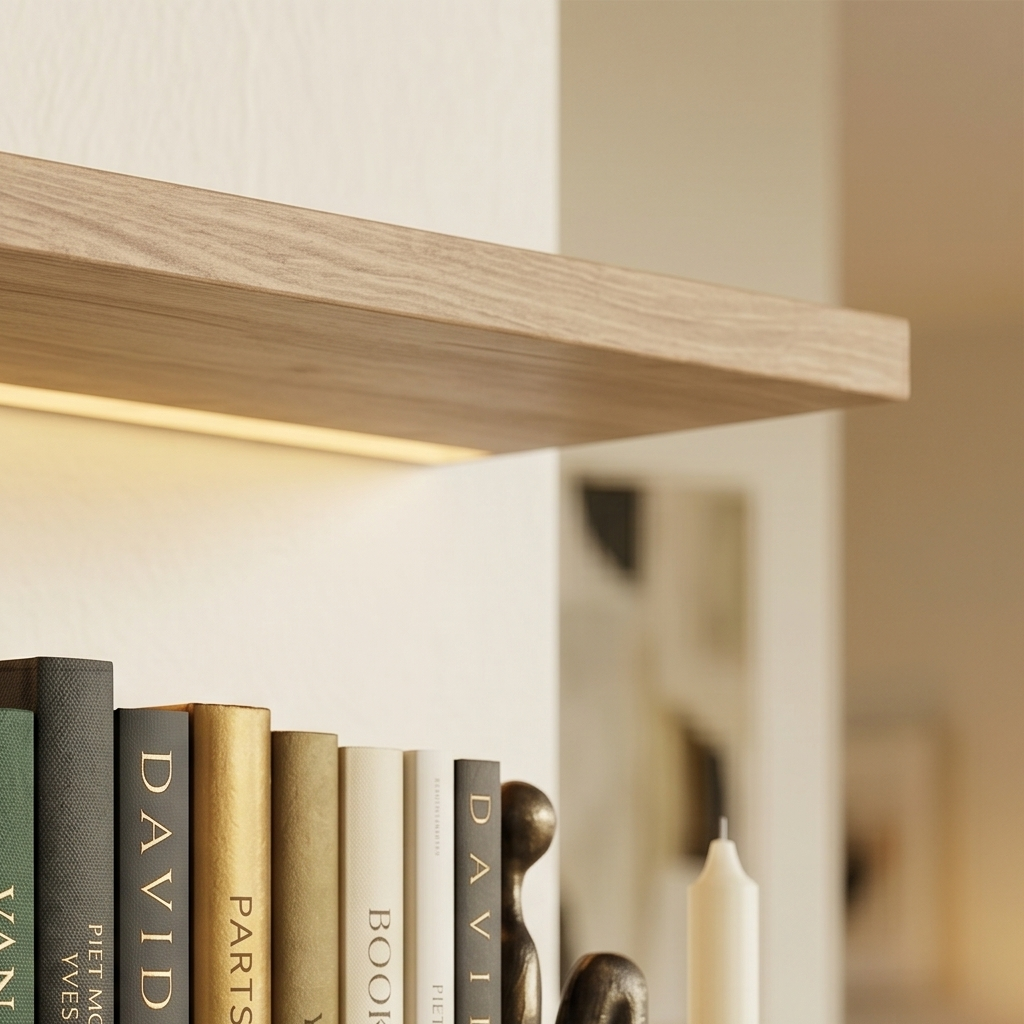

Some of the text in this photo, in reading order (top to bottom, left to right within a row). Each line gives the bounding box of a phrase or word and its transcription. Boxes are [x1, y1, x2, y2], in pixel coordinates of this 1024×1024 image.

[140, 750, 173, 1010] DAVID
[88, 924, 103, 979] PIET
[61, 952, 79, 1020] YVES
